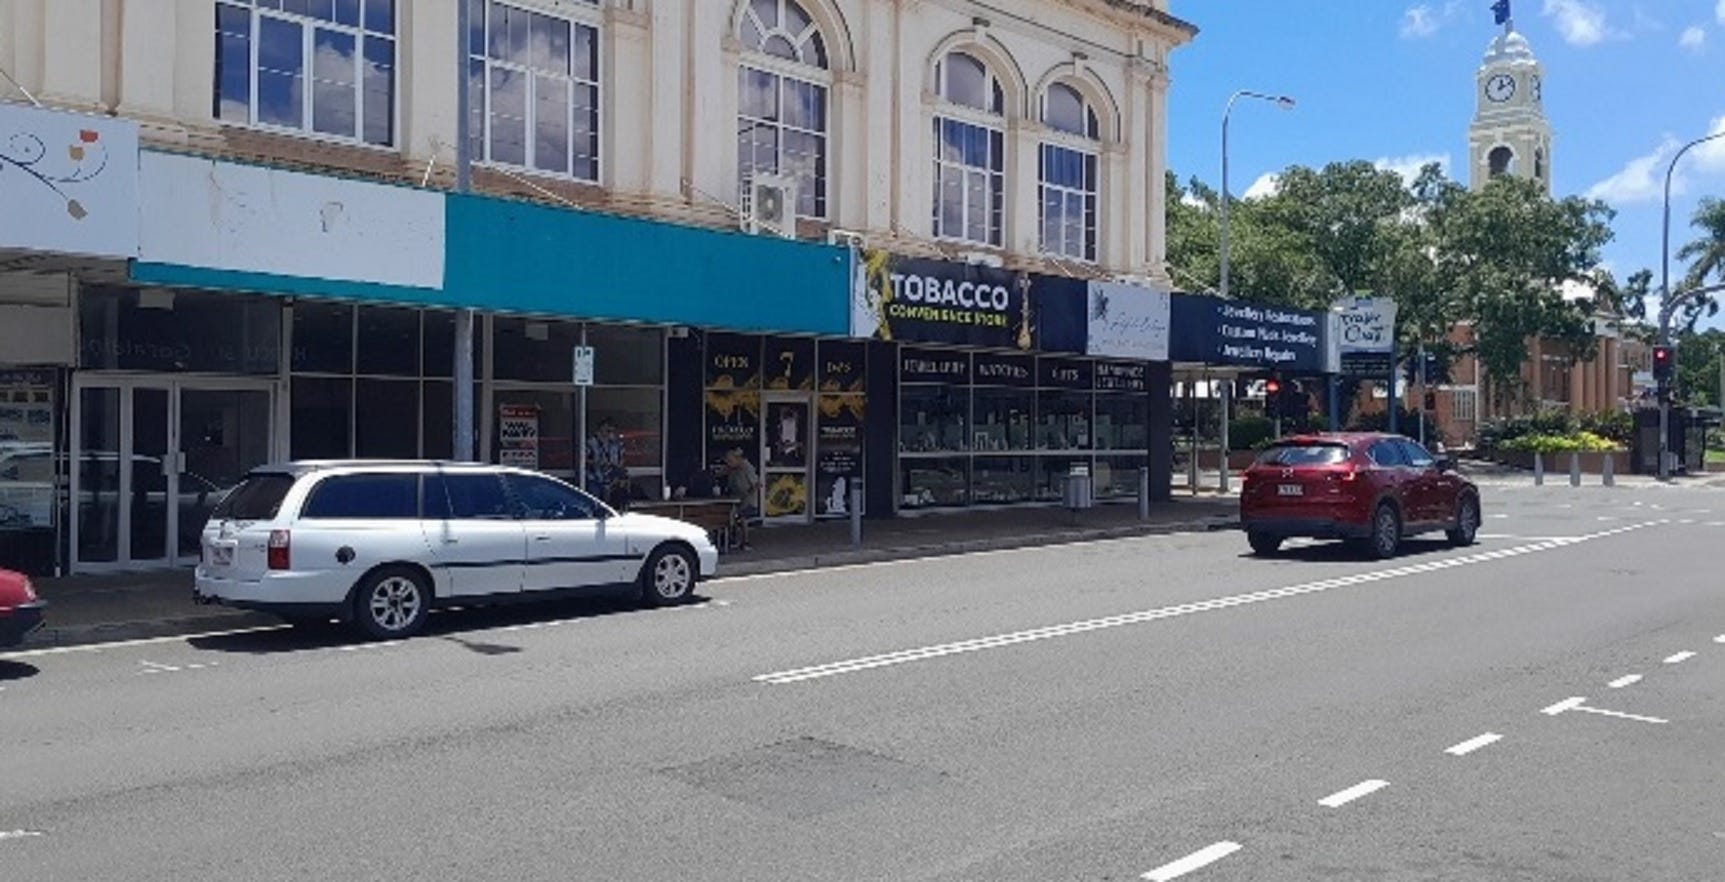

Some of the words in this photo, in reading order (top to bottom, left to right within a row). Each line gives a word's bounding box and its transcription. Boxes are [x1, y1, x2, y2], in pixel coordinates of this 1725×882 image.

[890, 274, 1009, 311] TOBACCO
[889, 303, 973, 324] CONVENIENCE
[974, 315, 1008, 328] STORE
[713, 354, 749, 369] OPEN
[779, 351, 795, 377] 7
